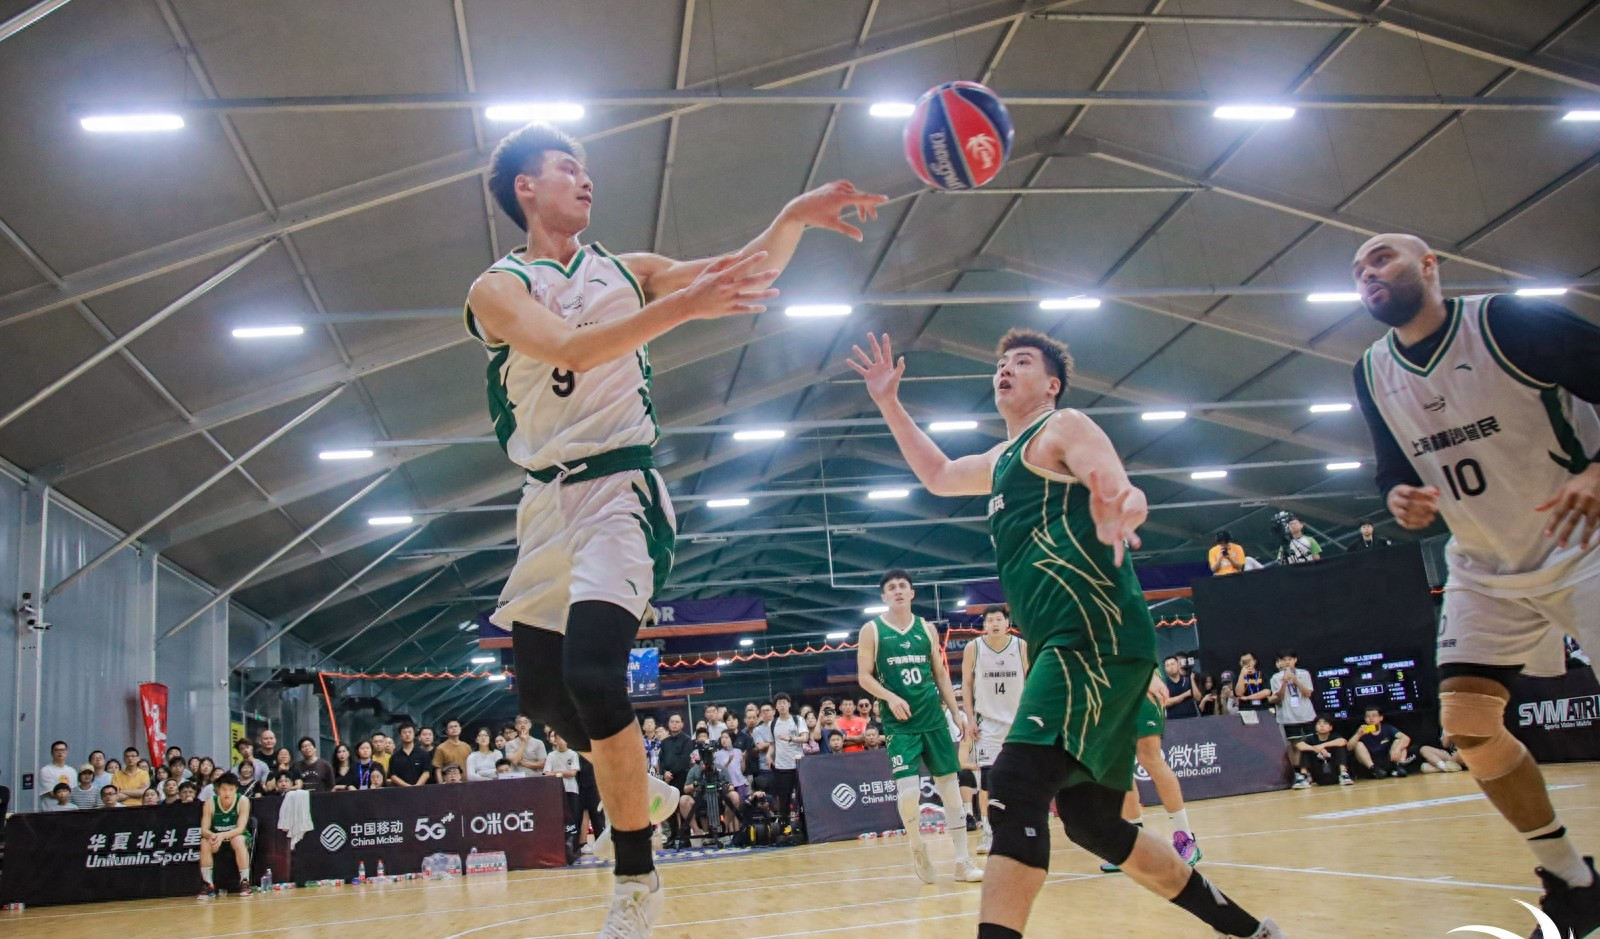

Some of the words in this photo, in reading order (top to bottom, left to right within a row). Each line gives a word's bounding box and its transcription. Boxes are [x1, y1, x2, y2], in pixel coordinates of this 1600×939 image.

[552, 367, 575, 398] 9
[1441, 458, 1488, 501] 10
[901, 667, 922, 685] 30
[1329, 679, 1341, 688] 13
[995, 682, 1006, 695] 14
[1168, 741, 1217, 768] 微博
[861, 796, 885, 804] China
[350, 820, 404, 836] 中国移动
[470, 810, 534, 835] 咪咕
[87, 827, 202, 852] 华夏北斗星
[351, 837, 375, 847] China
[376, 835, 404, 845] Mobile
[150, 848, 201, 866] Sports
